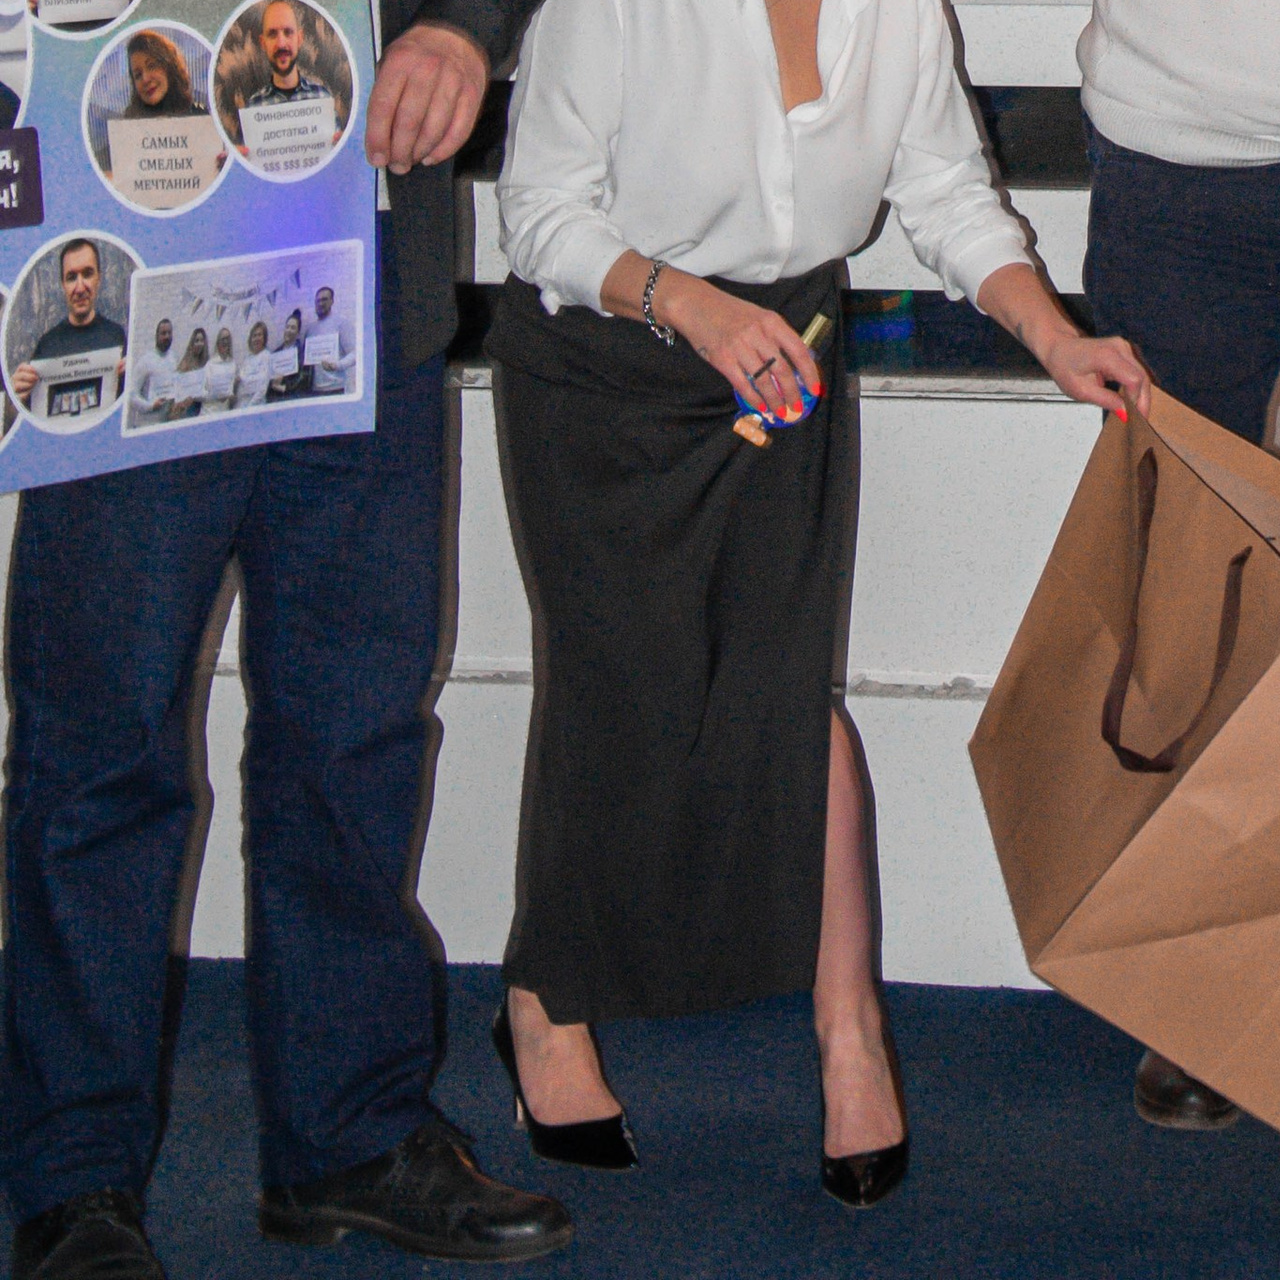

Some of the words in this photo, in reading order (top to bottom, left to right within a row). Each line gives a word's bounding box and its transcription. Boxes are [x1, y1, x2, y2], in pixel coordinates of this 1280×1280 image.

[254, 105, 322, 122] Финансового
[263, 126, 309, 143] достатка
[311, 125, 318, 134] и
[141, 136, 188, 150] САМЫХ
[256, 141, 326, 157] благополучия
[139, 158, 193, 171] СМЕЛЫХ
[134, 176, 200, 191] МЕЧТАНИЙ
